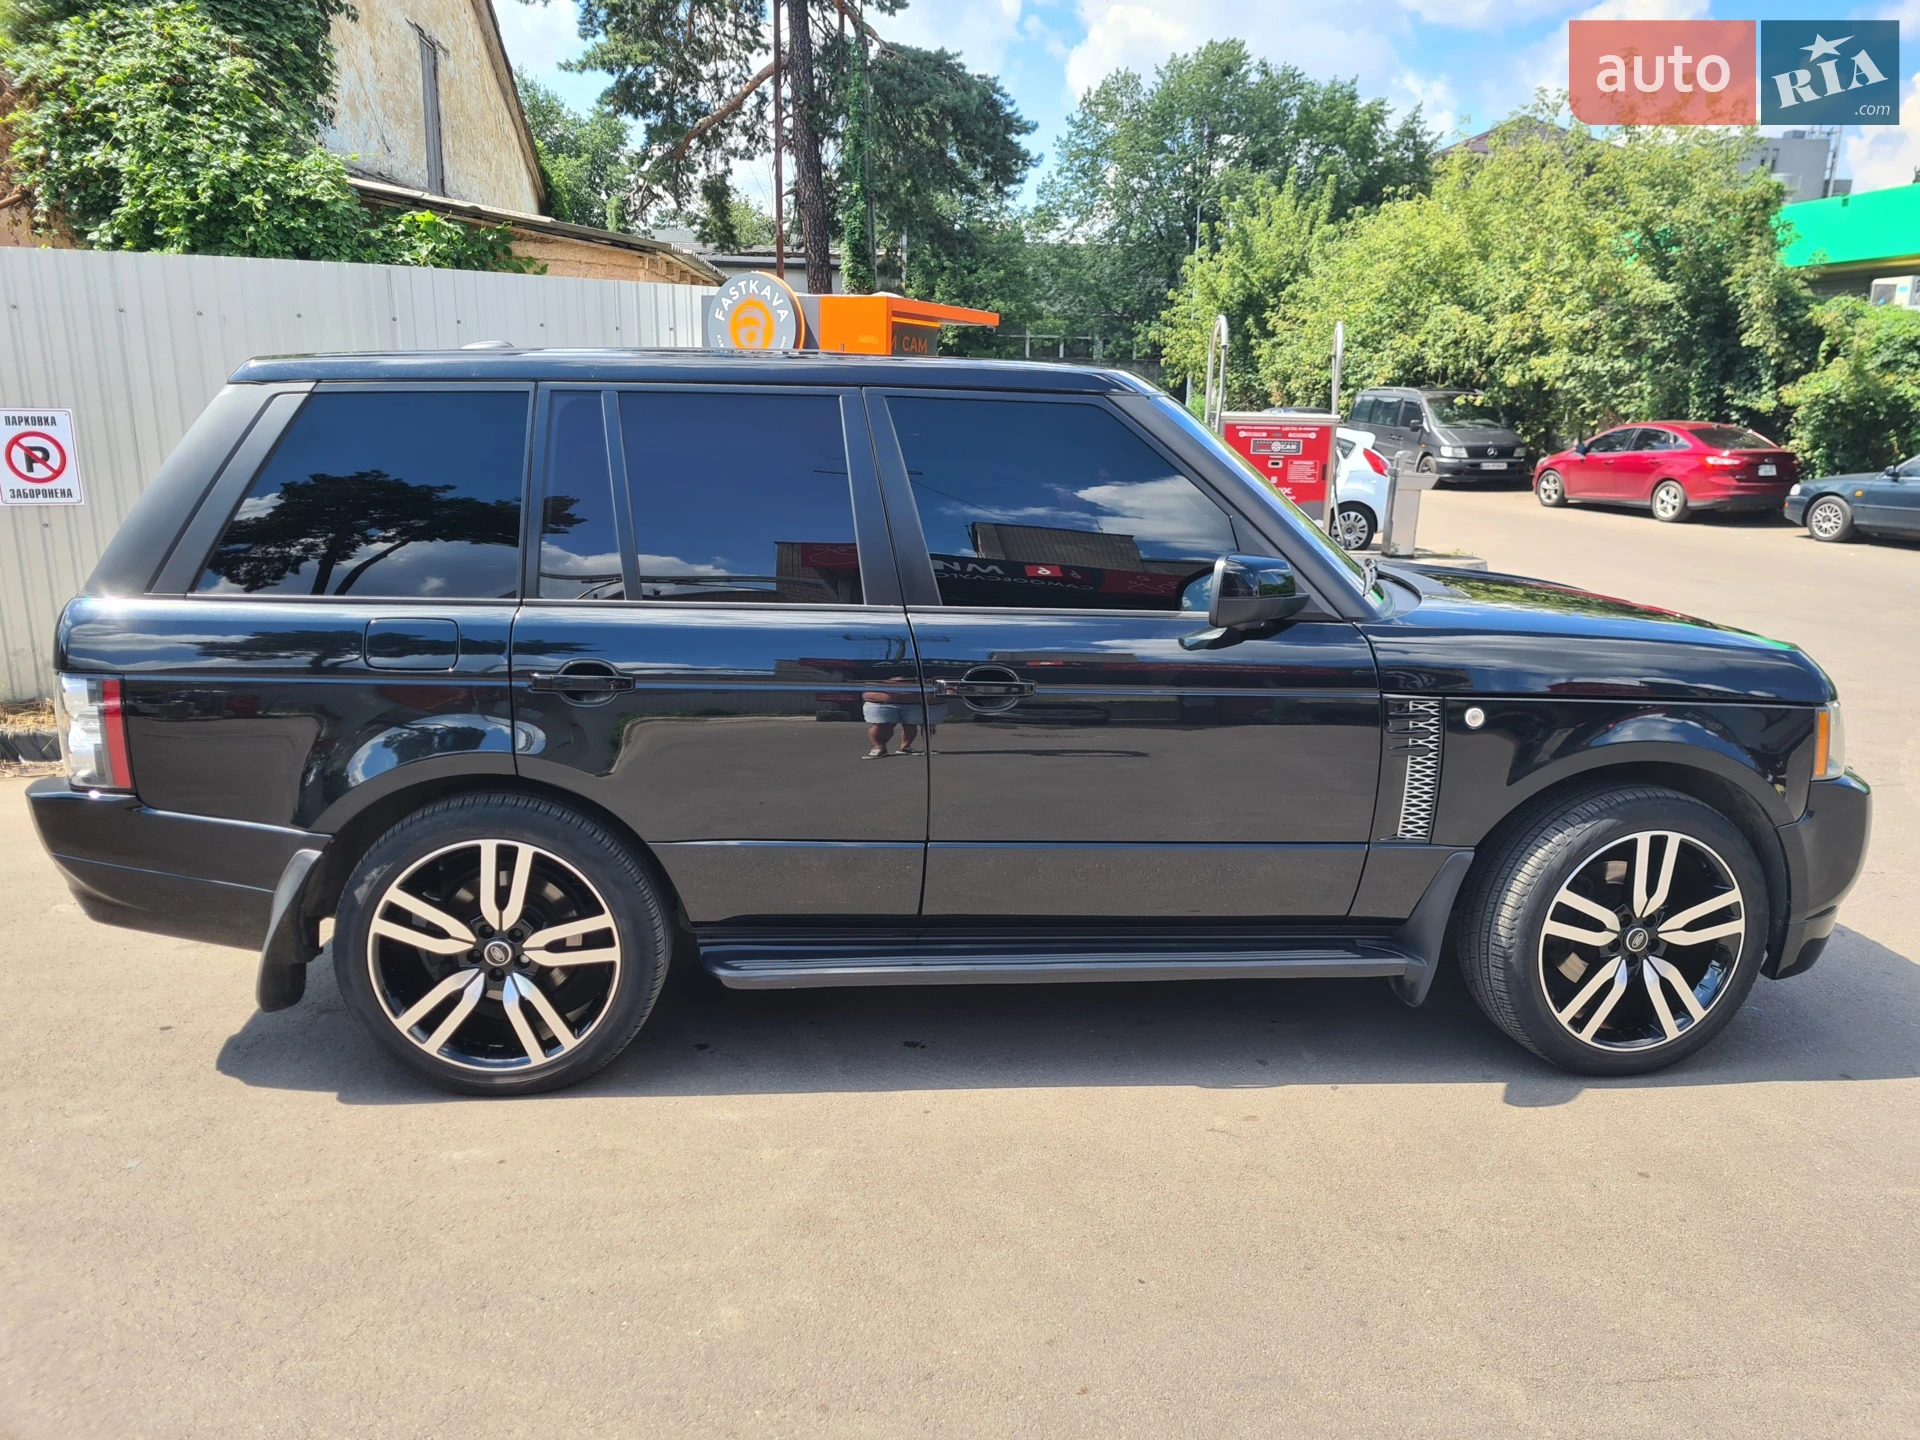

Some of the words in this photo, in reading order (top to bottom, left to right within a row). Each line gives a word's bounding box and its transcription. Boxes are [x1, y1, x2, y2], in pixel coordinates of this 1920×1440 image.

[714, 279, 789, 323] FASTKAVA
[4, 415, 57, 426] ПАРКОВКА
[9, 488, 73, 499] ЗАБОРОНЕНА
